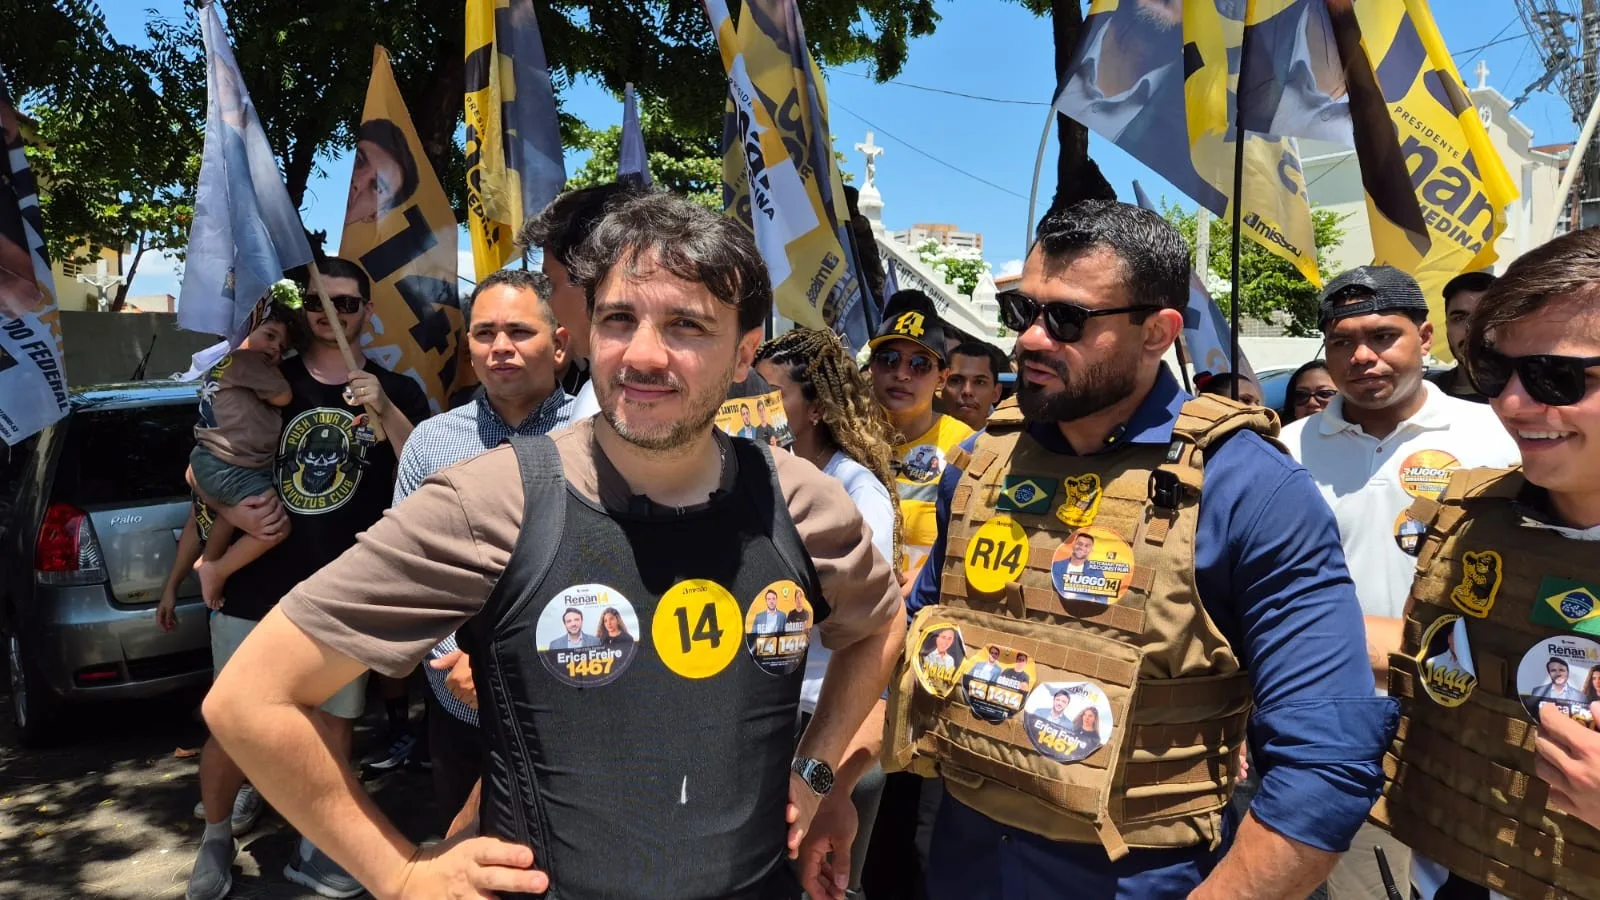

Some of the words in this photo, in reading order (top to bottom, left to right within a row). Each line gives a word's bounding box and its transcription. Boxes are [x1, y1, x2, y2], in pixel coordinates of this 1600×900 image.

[1393, 105, 1459, 159] PRESIDENTE
[1396, 134, 1494, 242] nan
[2, 318, 35, 341] DO
[20, 340, 69, 413] FEDERAL
[288, 419, 311, 446] PUSH
[313, 413, 341, 424] YOUR
[283, 480, 326, 508] INVICTUS
[330, 480, 354, 503] CLUB
[110, 515, 142, 527] Palio
[970, 537, 1022, 574] R14
[1067, 573, 1105, 587] HUGGO
[1106, 580, 1117, 591] 14
[673, 602, 724, 654] 14
[557, 652, 587, 664] Erica
[588, 648, 622, 660] Freire
[566, 657, 614, 677] 1467
[1426, 662, 1471, 693] 1444
[1034, 719, 1058, 735] Erica
[1058, 730, 1087, 749] Freire
[1037, 730, 1078, 756] 1467
